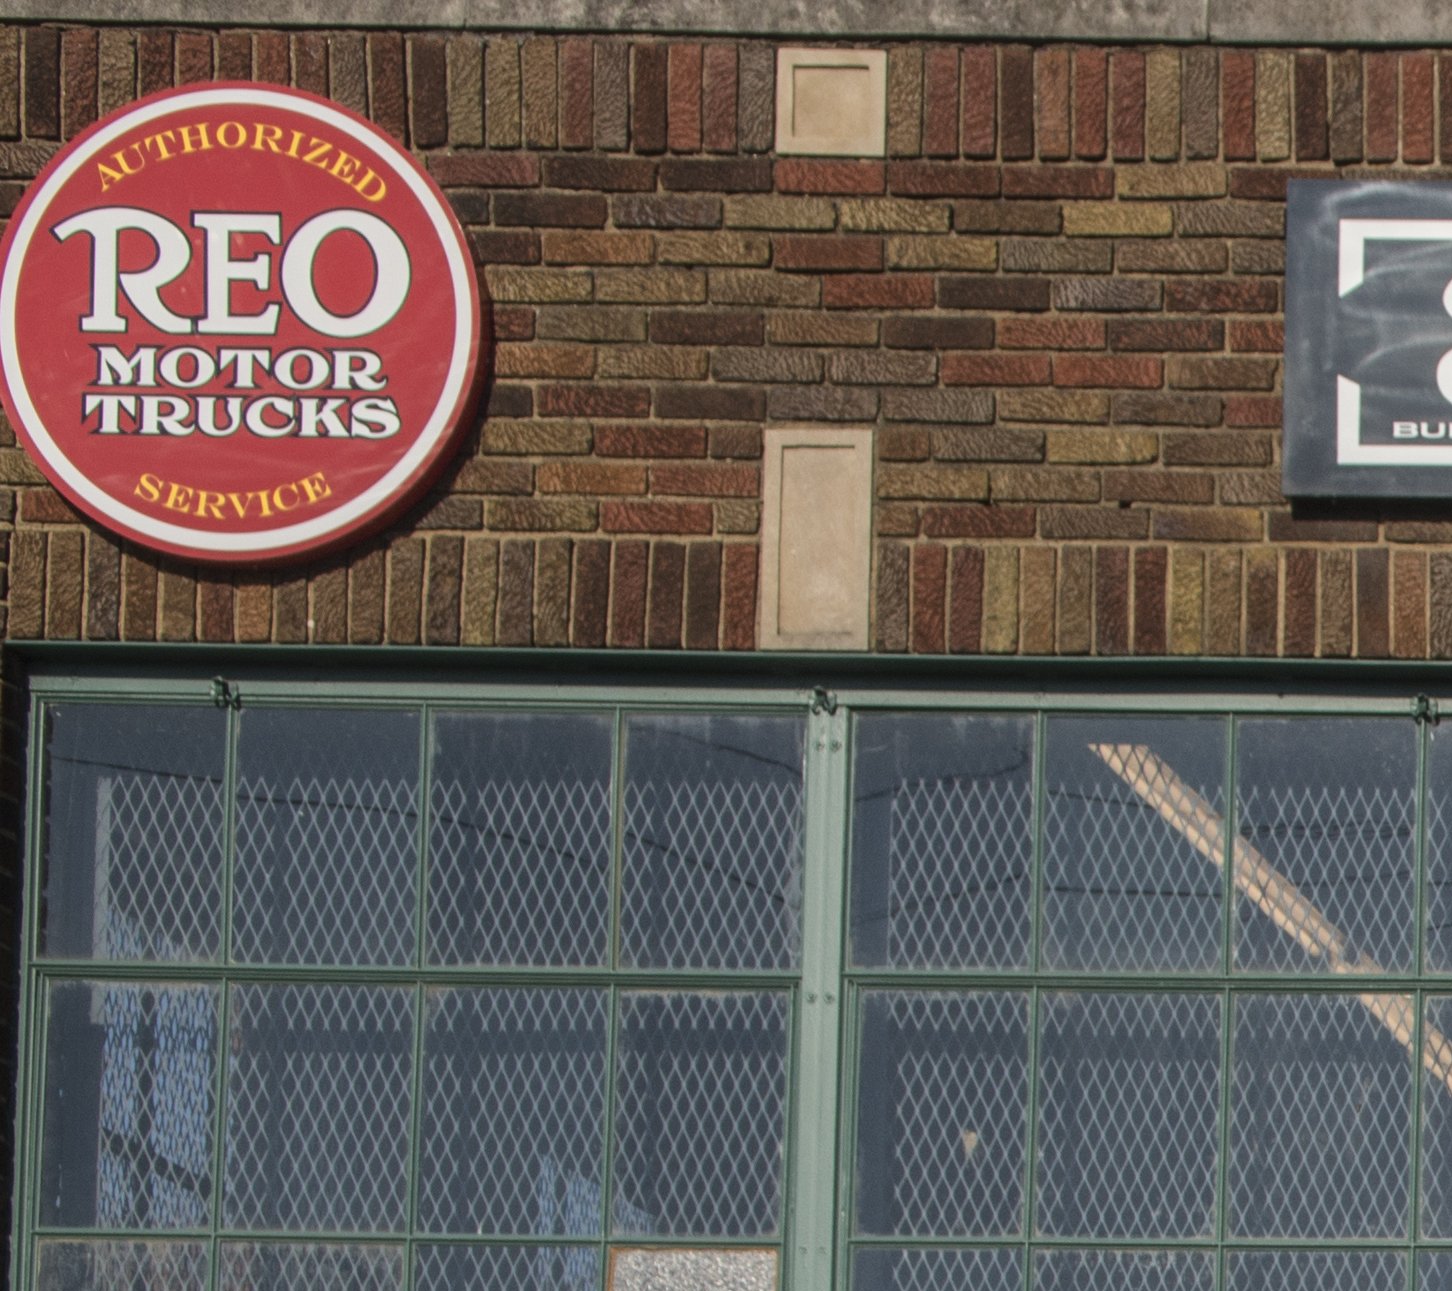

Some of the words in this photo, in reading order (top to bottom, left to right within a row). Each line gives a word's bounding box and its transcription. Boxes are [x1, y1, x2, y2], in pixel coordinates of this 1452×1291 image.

[96, 121, 387, 203] AUTHORIZED
[50, 205, 412, 339] REO
[90, 343, 389, 392] MOTOR
[82, 392, 402, 440] TRUCKS
[133, 471, 332, 520] SERVICE
